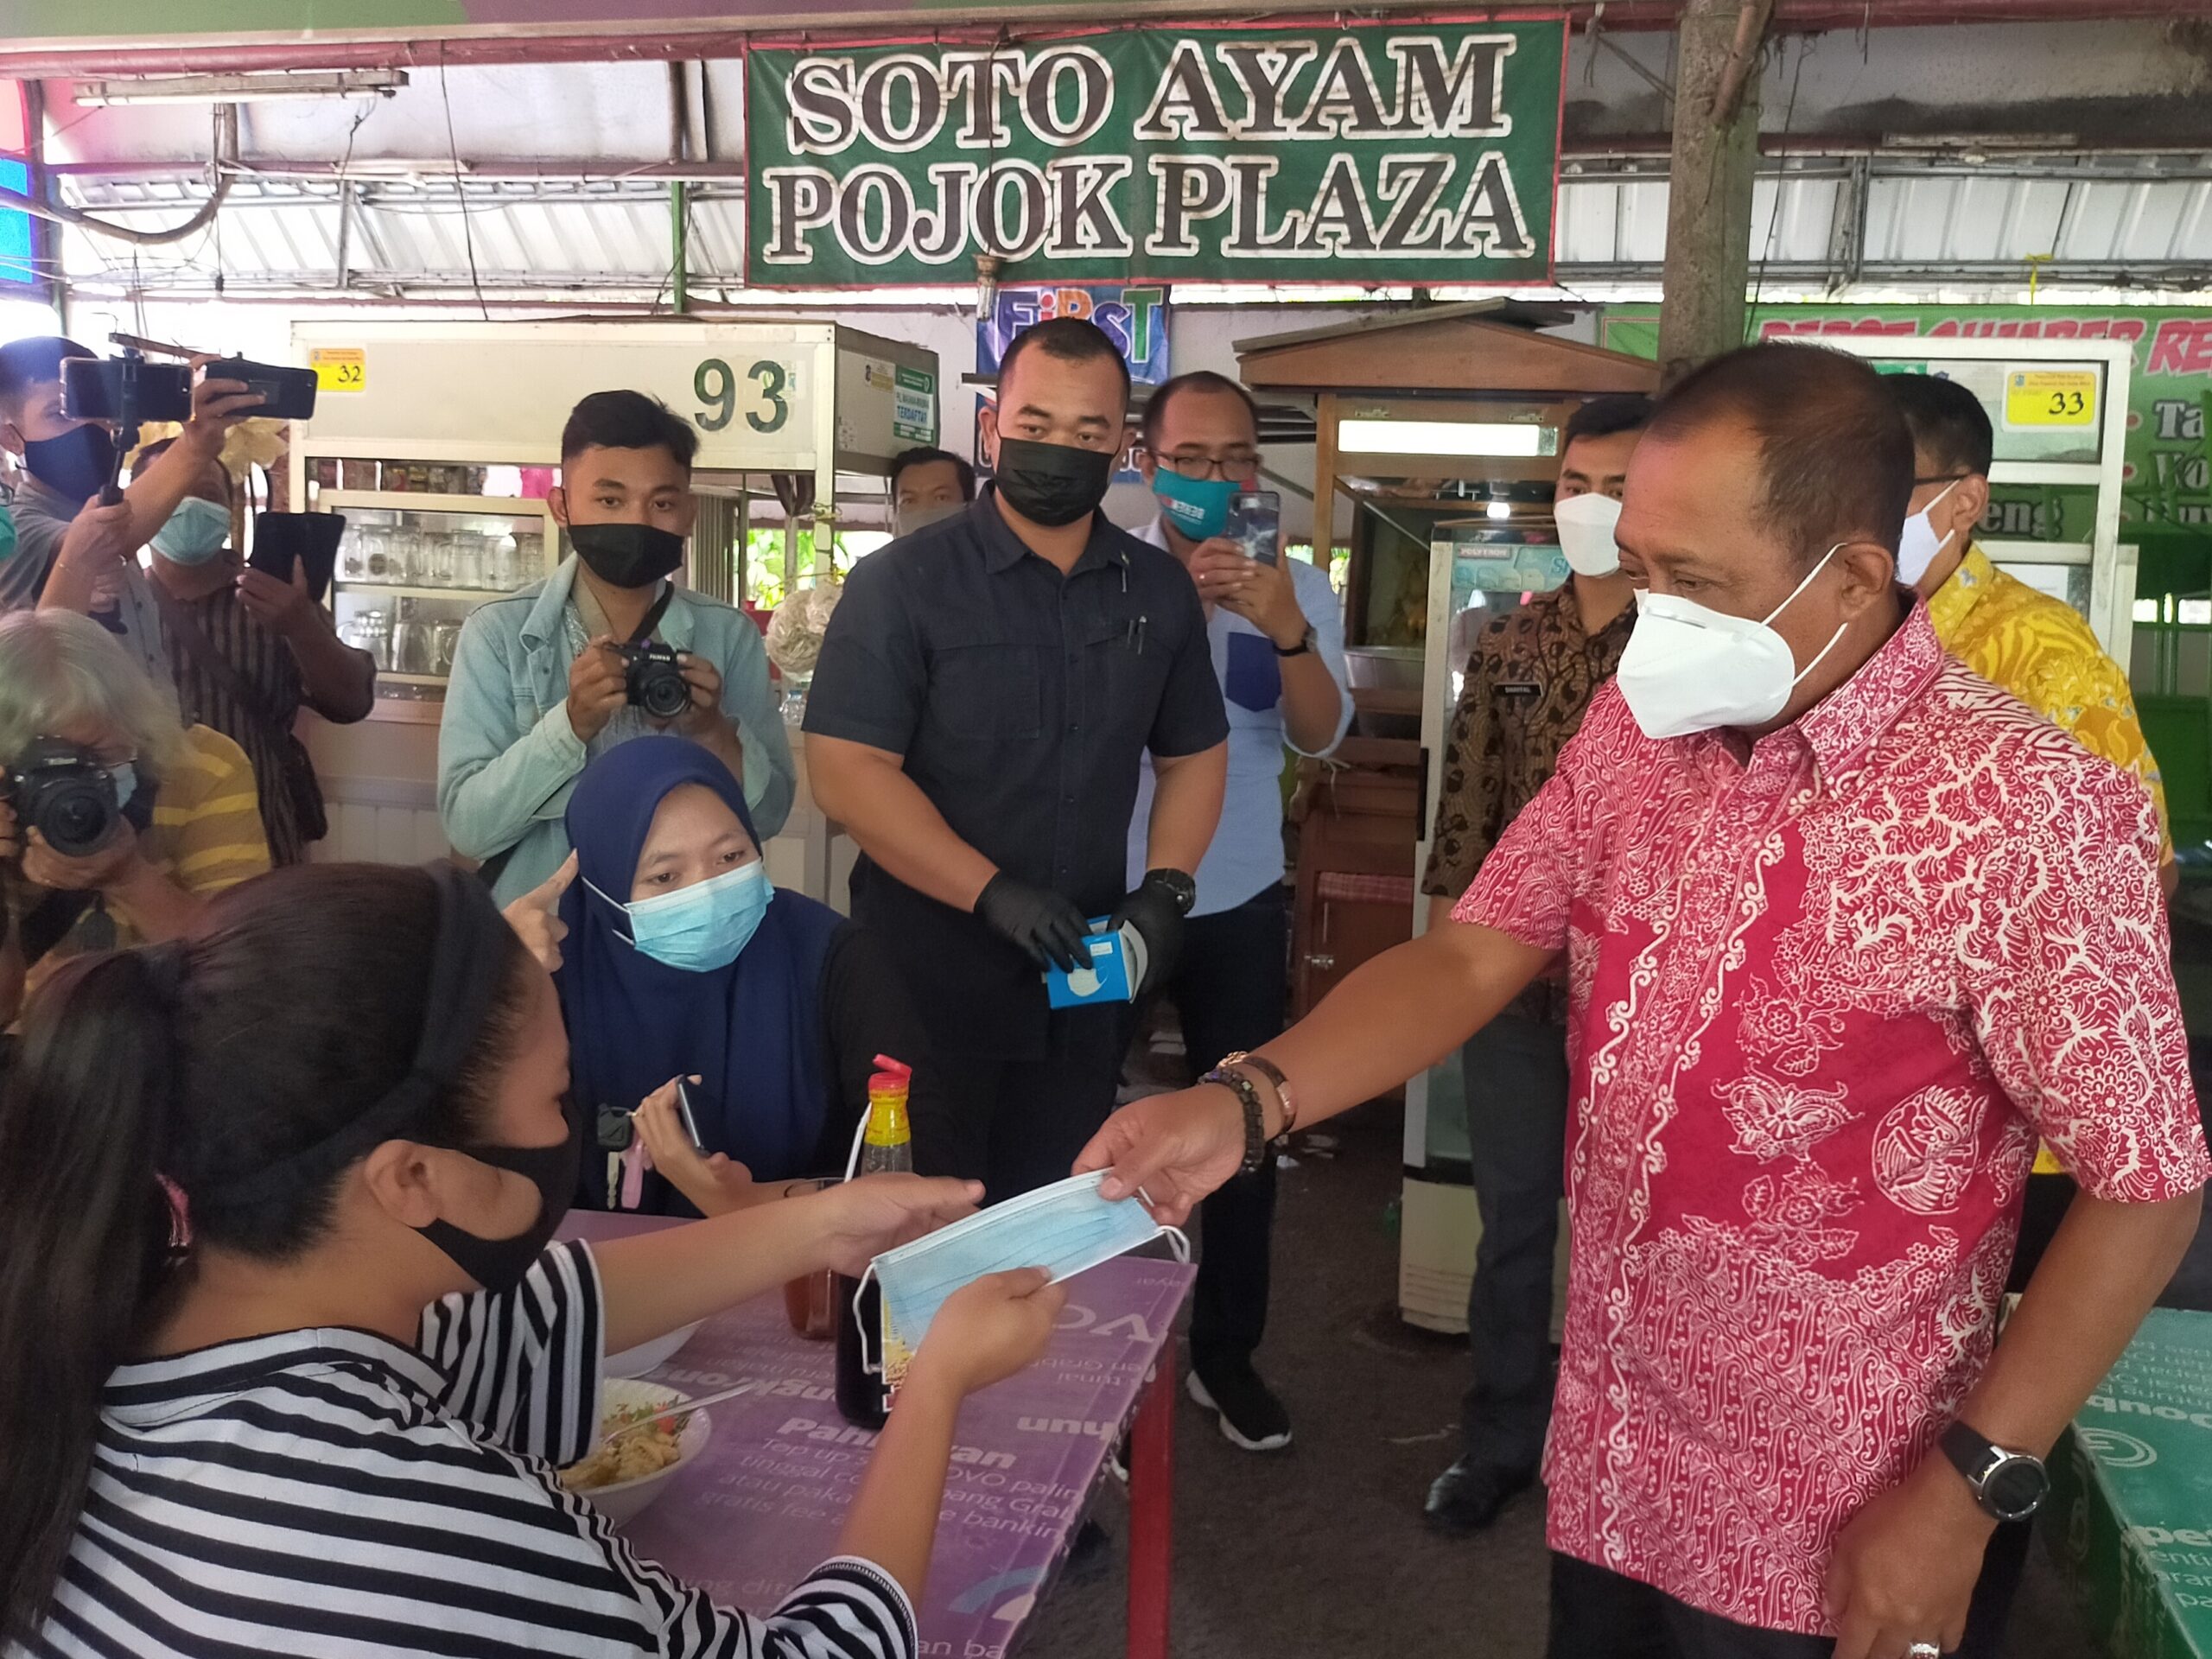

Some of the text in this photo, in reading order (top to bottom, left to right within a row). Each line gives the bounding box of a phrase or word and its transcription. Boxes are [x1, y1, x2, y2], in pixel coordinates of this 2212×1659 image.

[786, 33, 1517, 156] SOTO AYAM
[761, 151, 1536, 267] POJOK PLAZA
[338, 365, 362, 383] 32
[693, 358, 789, 434] 93
[2049, 391, 2084, 416] 33
[763, 1437, 809, 1457] Top
[814, 1448, 851, 1465] up
[1009, 1480, 1082, 1500] palin
[784, 1484, 853, 1504] paka
[963, 1510, 1061, 1539] bankin
